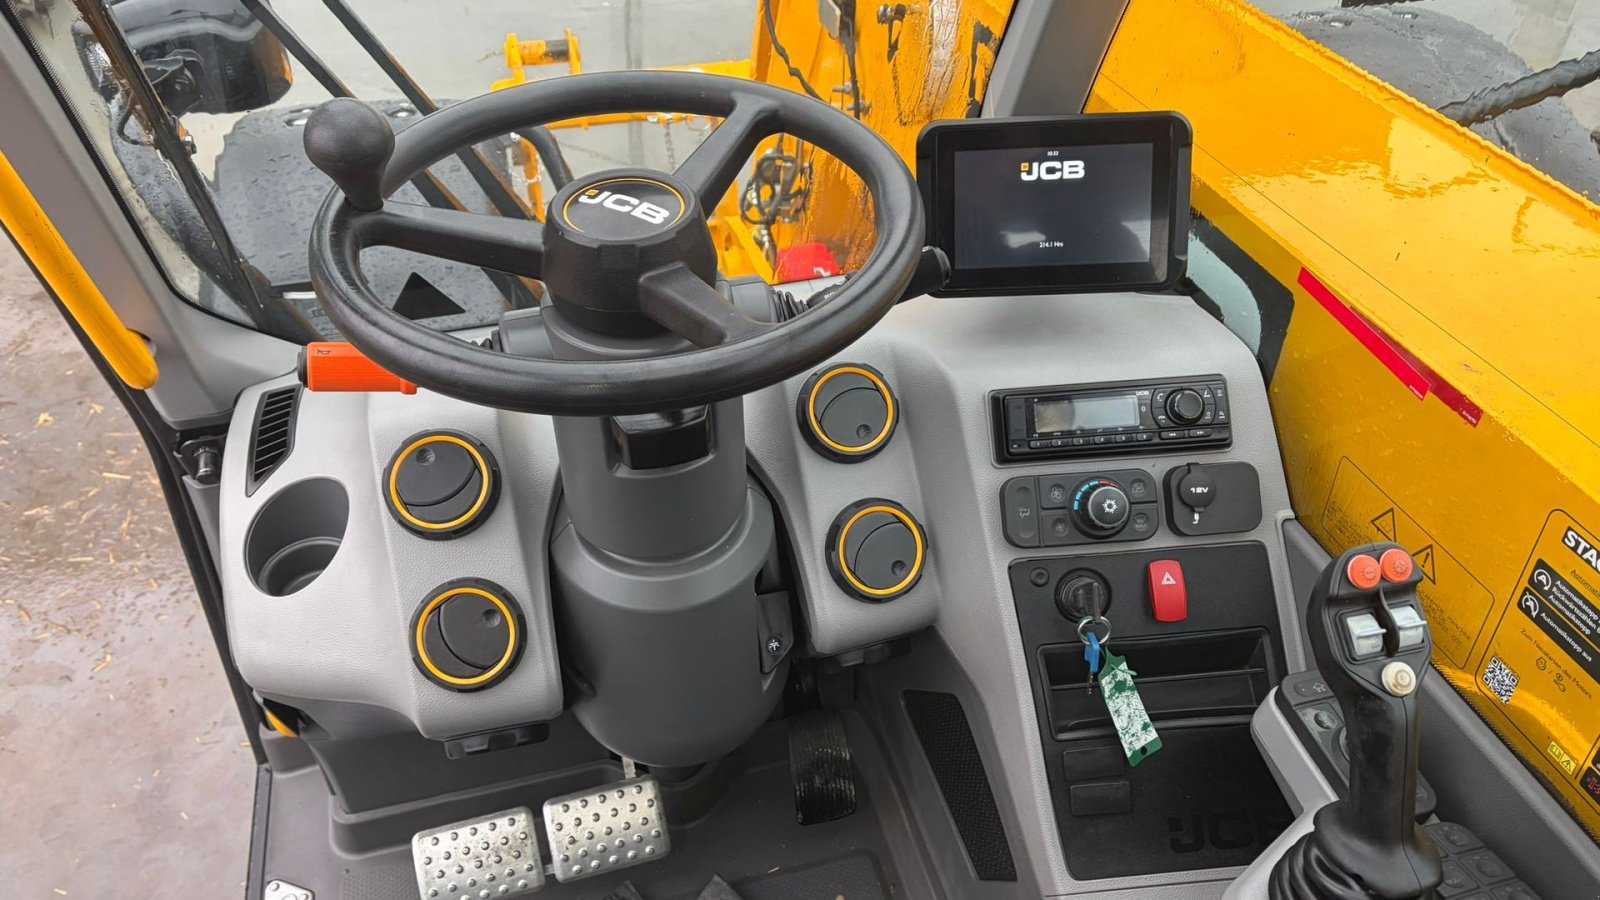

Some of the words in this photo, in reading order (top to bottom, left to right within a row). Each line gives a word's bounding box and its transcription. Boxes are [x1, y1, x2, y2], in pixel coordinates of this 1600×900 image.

[1021, 160, 1085, 181] JCB
[578, 189, 670, 225] JCB
[1548, 595, 1591, 635] Automatikstopp
[1551, 586, 1596, 630] Rückwärtszählen
[1555, 580, 1599, 621] Automatikstopp
[1540, 612, 1582, 653] Automatikstopp
[1582, 651, 1592, 662] aus
[1520, 628, 1534, 642] Zum
[1533, 640, 1562, 669] Neustarten
[1572, 677, 1592, 699] Motors
